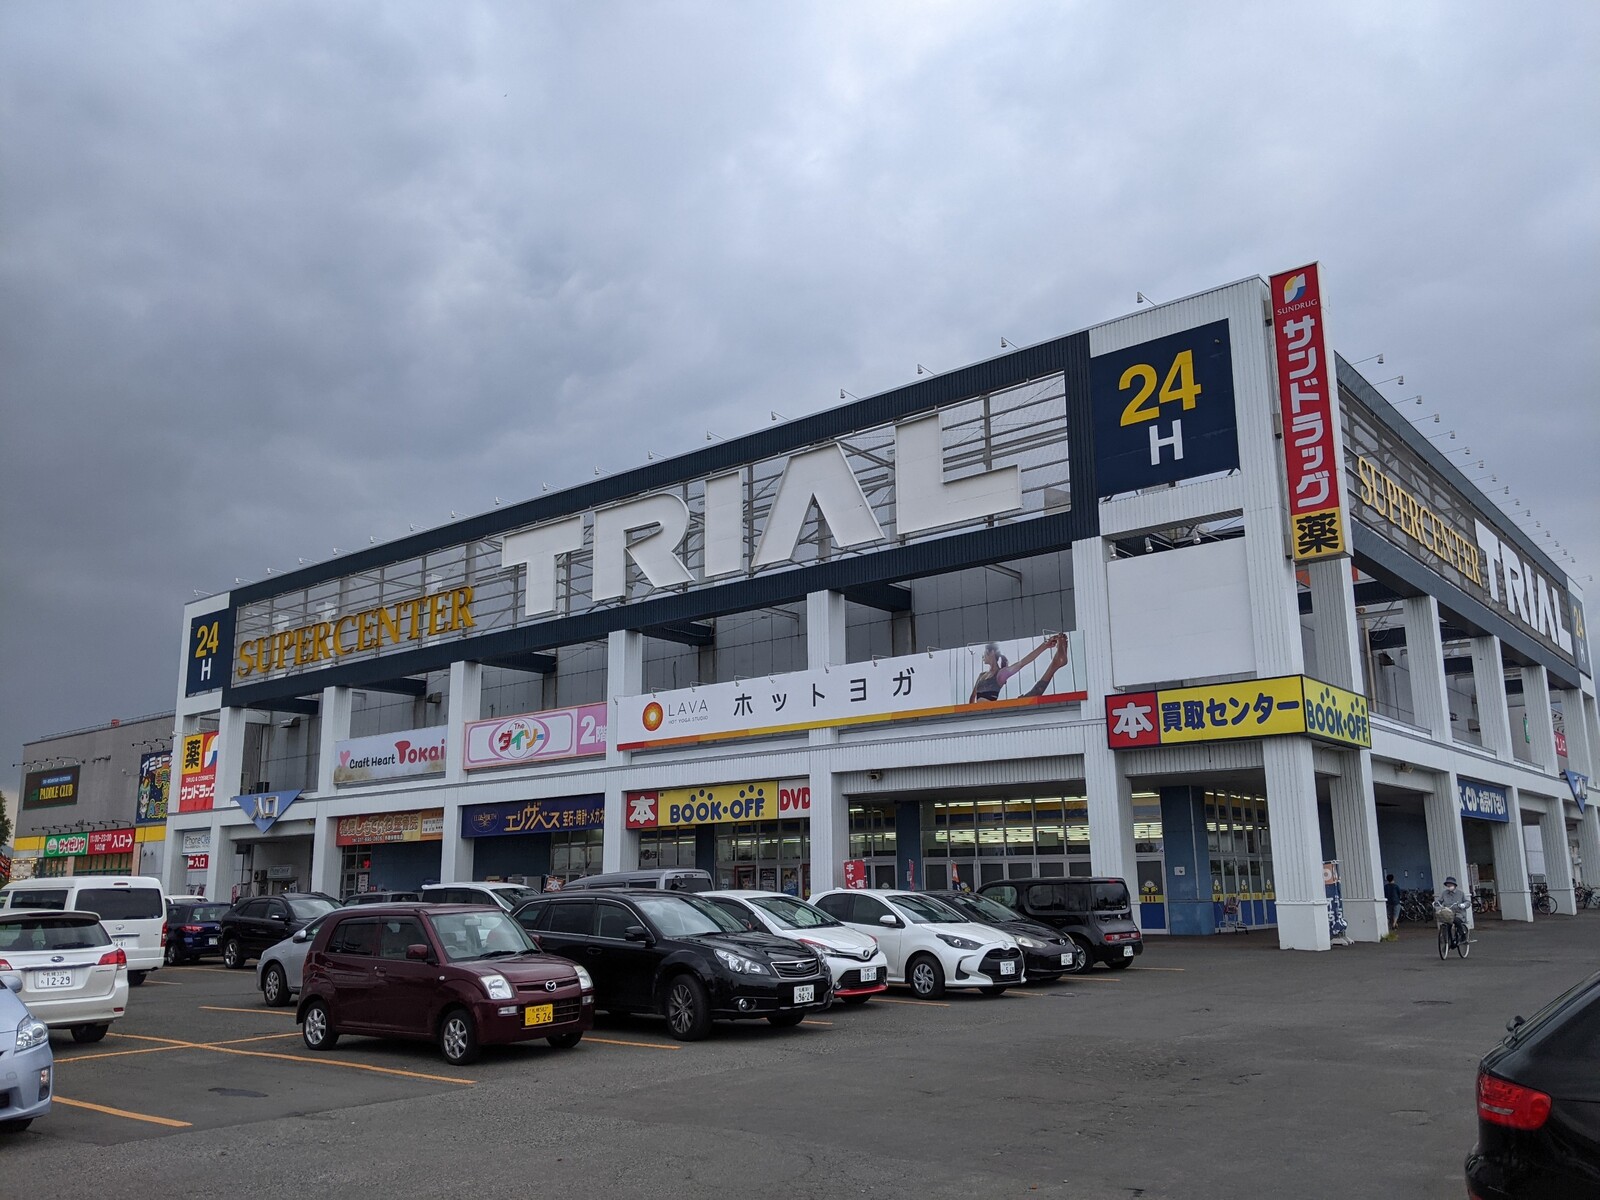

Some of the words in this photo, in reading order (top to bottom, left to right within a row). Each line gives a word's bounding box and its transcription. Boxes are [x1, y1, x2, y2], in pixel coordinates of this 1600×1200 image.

[1277, 299, 1318, 316] SUNDRUG
[1118, 350, 1202, 427] 24
[1283, 314, 1331, 508] サンドラッグ
[1149, 419, 1184, 466] H
[502, 413, 1023, 617] TRIAL
[1358, 456, 1482, 587] SUPERCENTER
[1295, 512, 1340, 554] 薬
[1474, 517, 1573, 656] TRIAL
[195, 621, 219, 658] 24
[237, 586, 478, 678] SUPERCENTER
[200, 657, 212, 682] H
[733, 667, 915, 717] ホットヨガ
[668, 699, 708, 716] LAVA
[1112, 702, 1154, 739] 本
[1161, 692, 1300, 732] 買取センター
[498, 729, 545, 751] ダイソー
[514, 722, 525, 730] The
[185, 739, 201, 769] 薬
[349, 756, 371, 770] Craft
[371, 753, 396, 767] Heart
[39, 786, 59, 801] PADDLE
[59, 783, 74, 797] CLUB
[779, 786, 811, 811] DVD
[503, 801, 561, 832] エリザベス
[629, 795, 656, 825] 本
[58, 836, 86, 854] サイゼリヤ
[111, 834, 125, 849] 入口
[194, 858, 206, 867] 入口
[47, 976, 71, 986] 12-29
